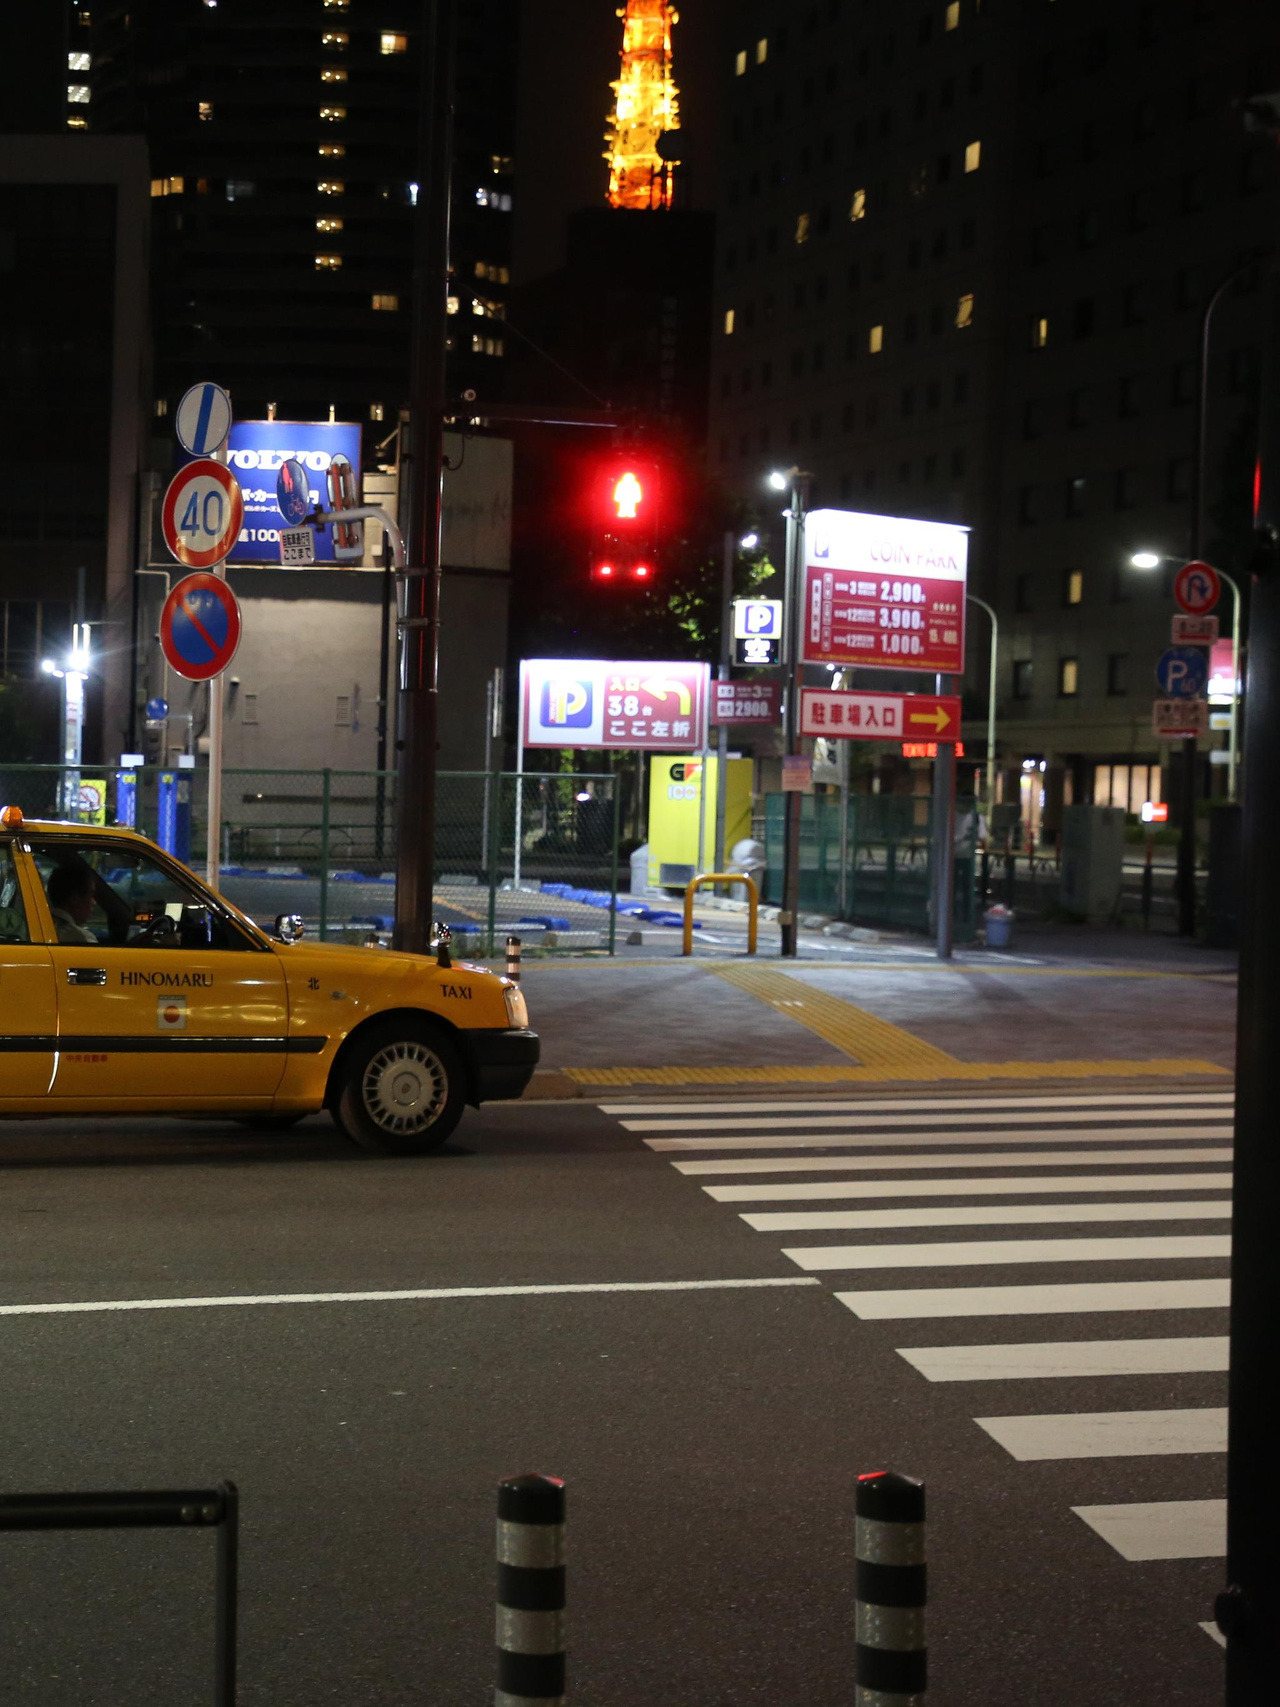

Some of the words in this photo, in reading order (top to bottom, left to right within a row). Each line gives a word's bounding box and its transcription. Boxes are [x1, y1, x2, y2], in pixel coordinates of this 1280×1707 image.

[180, 490, 224, 537] 40
[870, 540, 910, 564] COIN
[610, 677, 640, 692] 入口
[1167, 660, 1188, 693] P
[811, 702, 896, 727] 駐車場入口
[610, 720, 690, 738] ここ左折
[121, 972, 214, 988] HINOMARU
[308, 978, 319, 990] 北
[440, 984, 472, 999] TAXI
